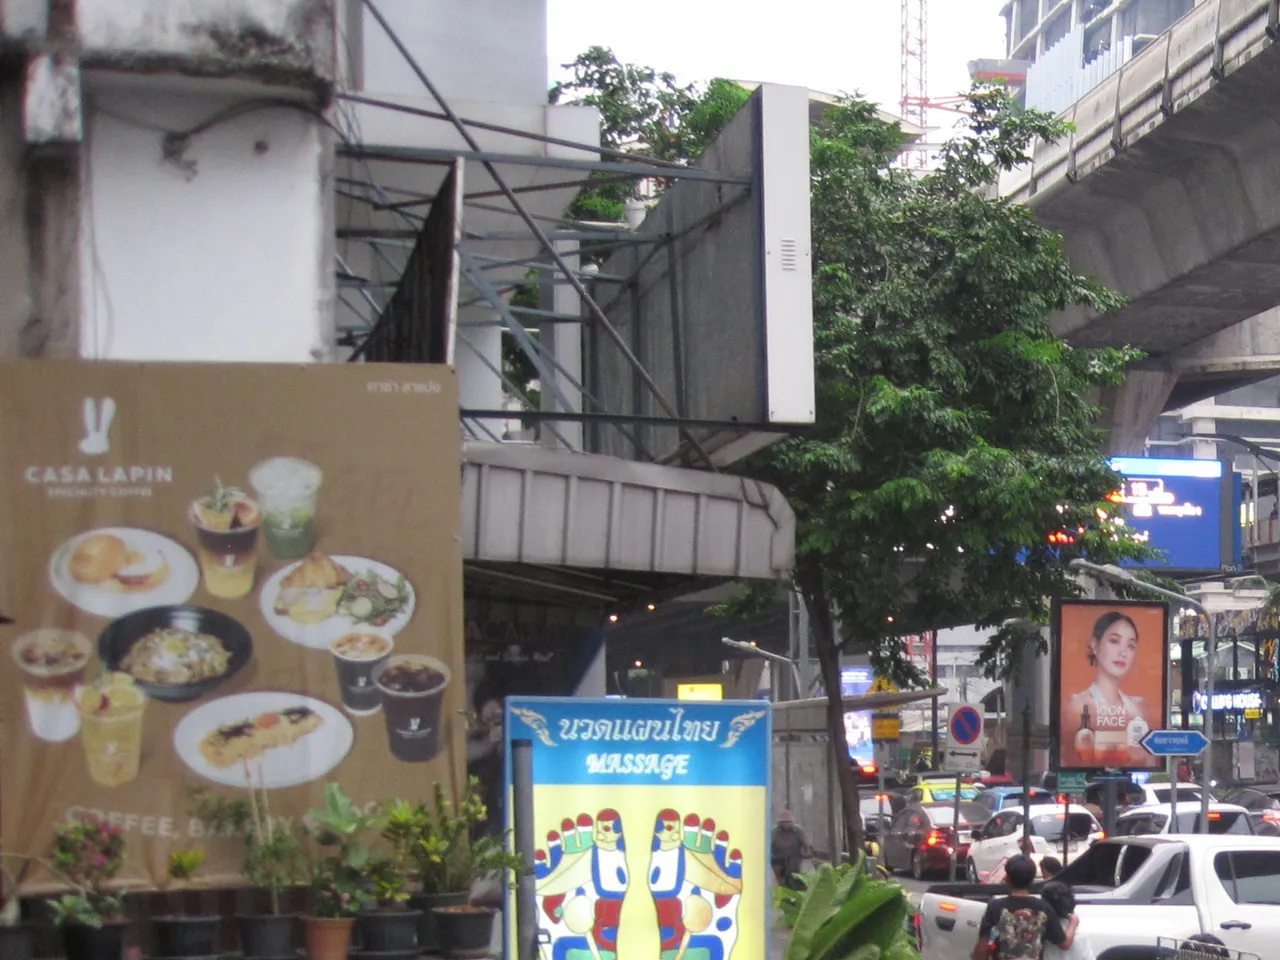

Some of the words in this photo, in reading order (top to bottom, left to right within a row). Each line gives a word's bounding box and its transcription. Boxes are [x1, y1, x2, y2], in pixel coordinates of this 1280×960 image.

[25, 466, 92, 484] CASA
[97, 466, 173, 483] LAPIN
[559, 707, 721, 742] นวดแผนไทย
[1096, 716, 1126, 727] FACE
[586, 753, 691, 780] MASSAGE
